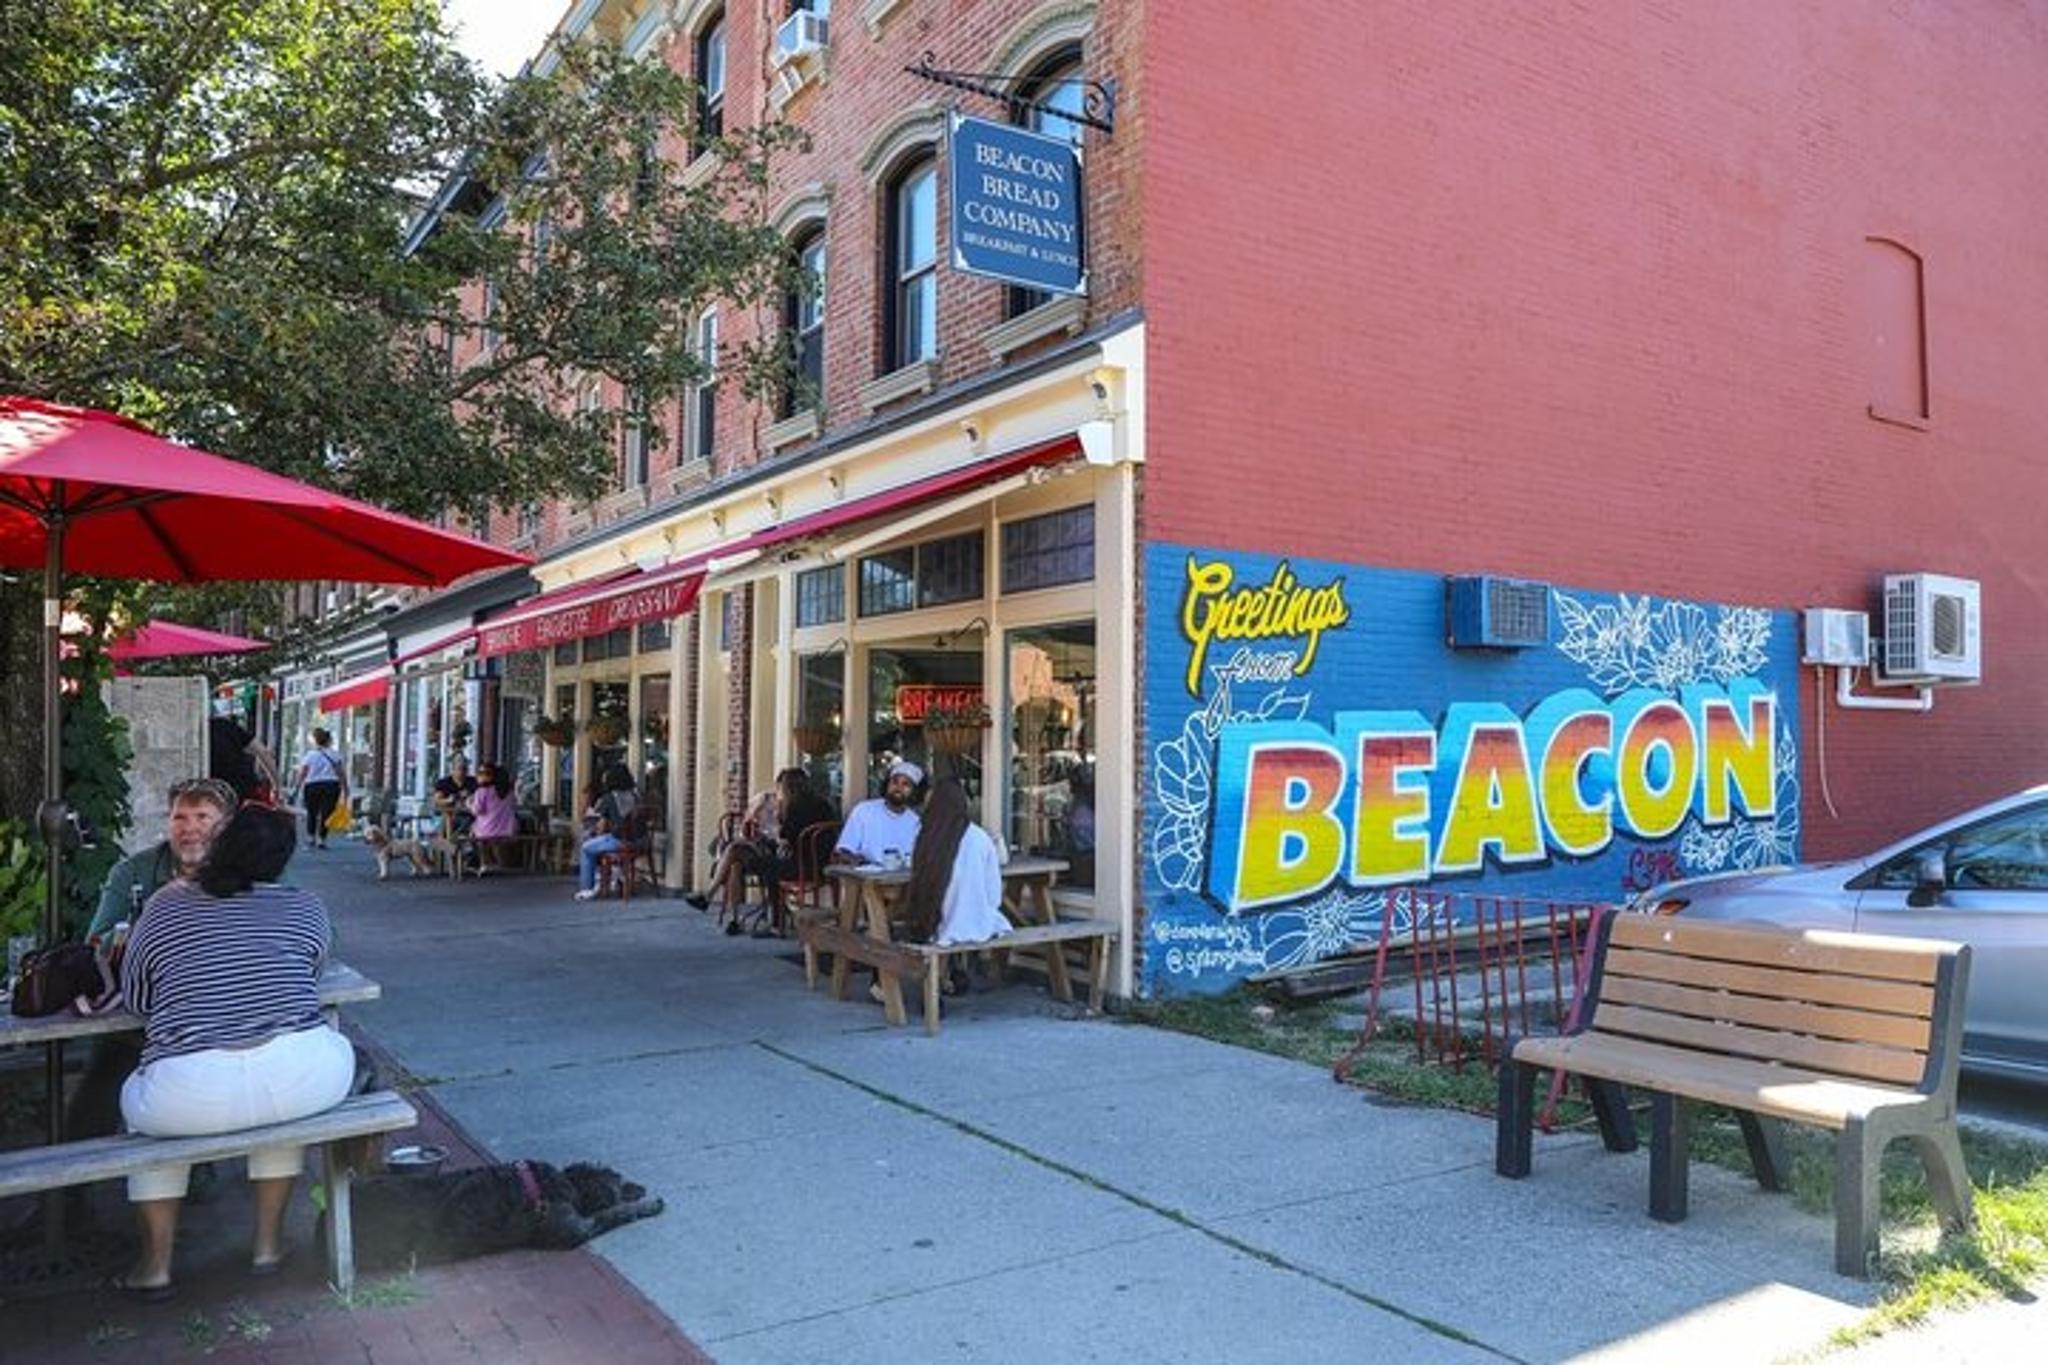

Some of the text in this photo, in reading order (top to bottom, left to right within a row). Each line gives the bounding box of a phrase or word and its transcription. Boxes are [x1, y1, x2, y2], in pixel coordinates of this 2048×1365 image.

[974, 143, 1065, 183] BEACON
[982, 174, 1060, 212] BREAD
[963, 201, 1075, 243] COMPANY
[1030, 246, 1040, 259] &
[1184, 553, 1349, 697] Greetings
[1232, 692, 1777, 914] BEACON
